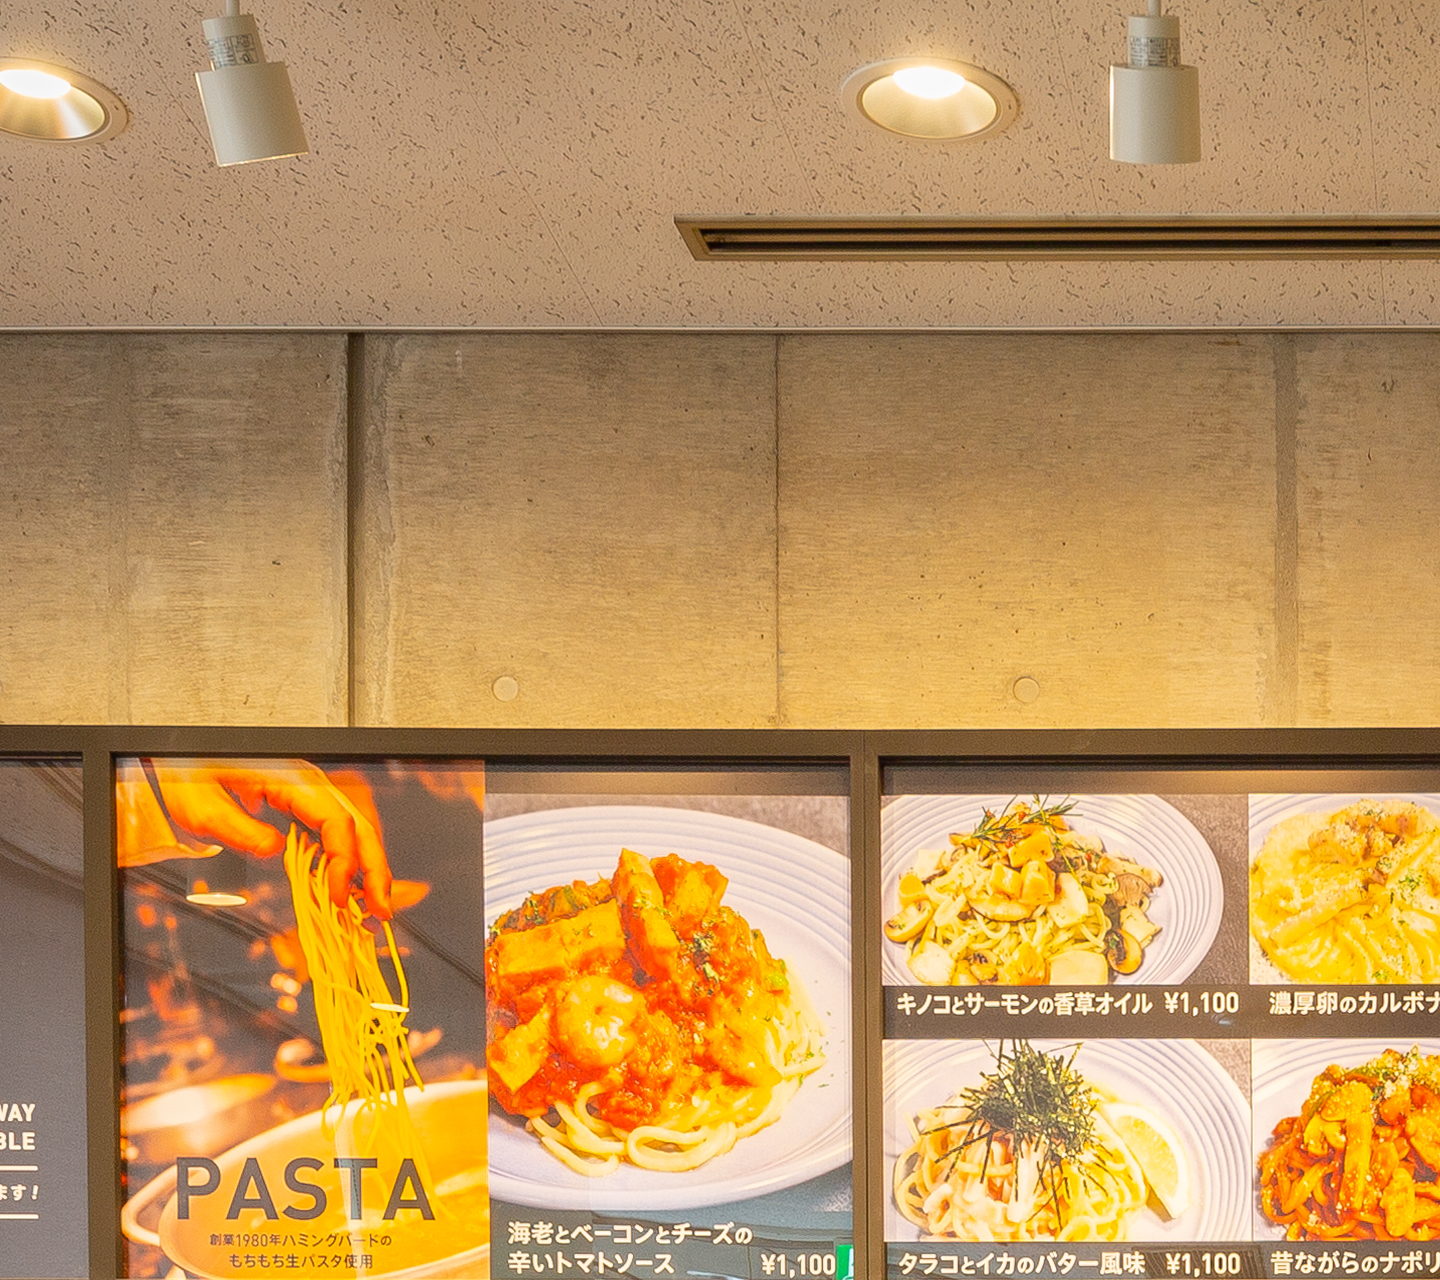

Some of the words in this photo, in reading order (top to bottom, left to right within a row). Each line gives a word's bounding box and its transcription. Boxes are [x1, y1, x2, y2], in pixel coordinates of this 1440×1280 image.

[896, 991, 1153, 1016] キノコとサーモンの香草オイル
[1164, 992, 1240, 1016] ¥1,100
[176, 1156, 434, 1221] PASTA
[210, 1233, 392, 1248] 創業1980年ハミングバードの
[508, 1221, 753, 1246] 海老とベーコンとチーズの
[229, 1254, 373, 1269] もちもち生パスタ使用
[508, 1251, 675, 1275] 辛いトマトソース
[760, 1253, 836, 1279] ¥1,100
[898, 1251, 1146, 1275] タラコとイカのバター風味
[1166, 1252, 1241, 1277] ¥1,100
